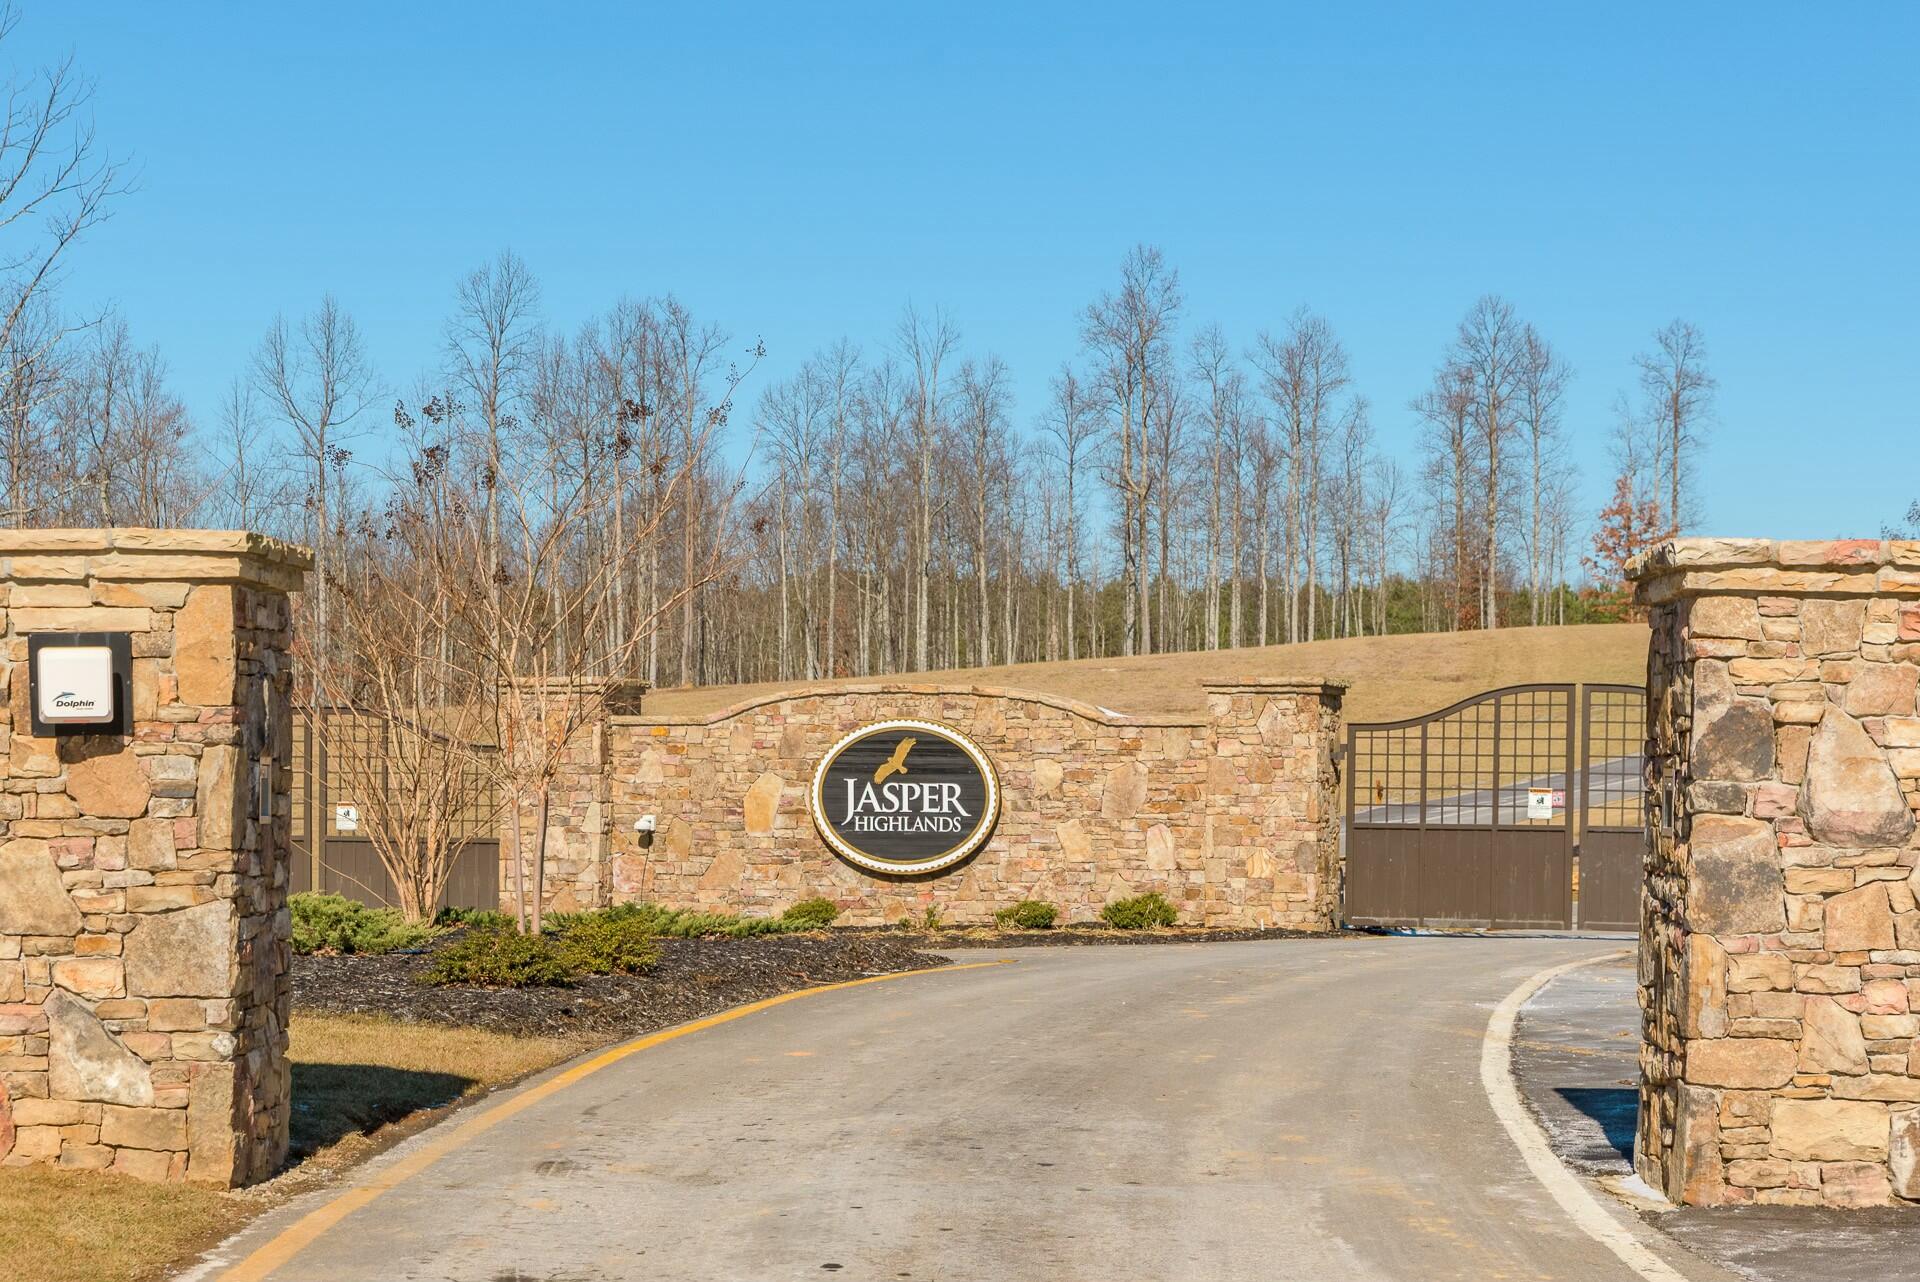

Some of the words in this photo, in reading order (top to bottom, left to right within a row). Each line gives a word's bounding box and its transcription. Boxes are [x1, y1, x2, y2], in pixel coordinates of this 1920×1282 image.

[56, 700, 94, 708] Dolphin
[841, 778, 972, 826] JASPER
[854, 816, 961, 832] HIGHLANDS
